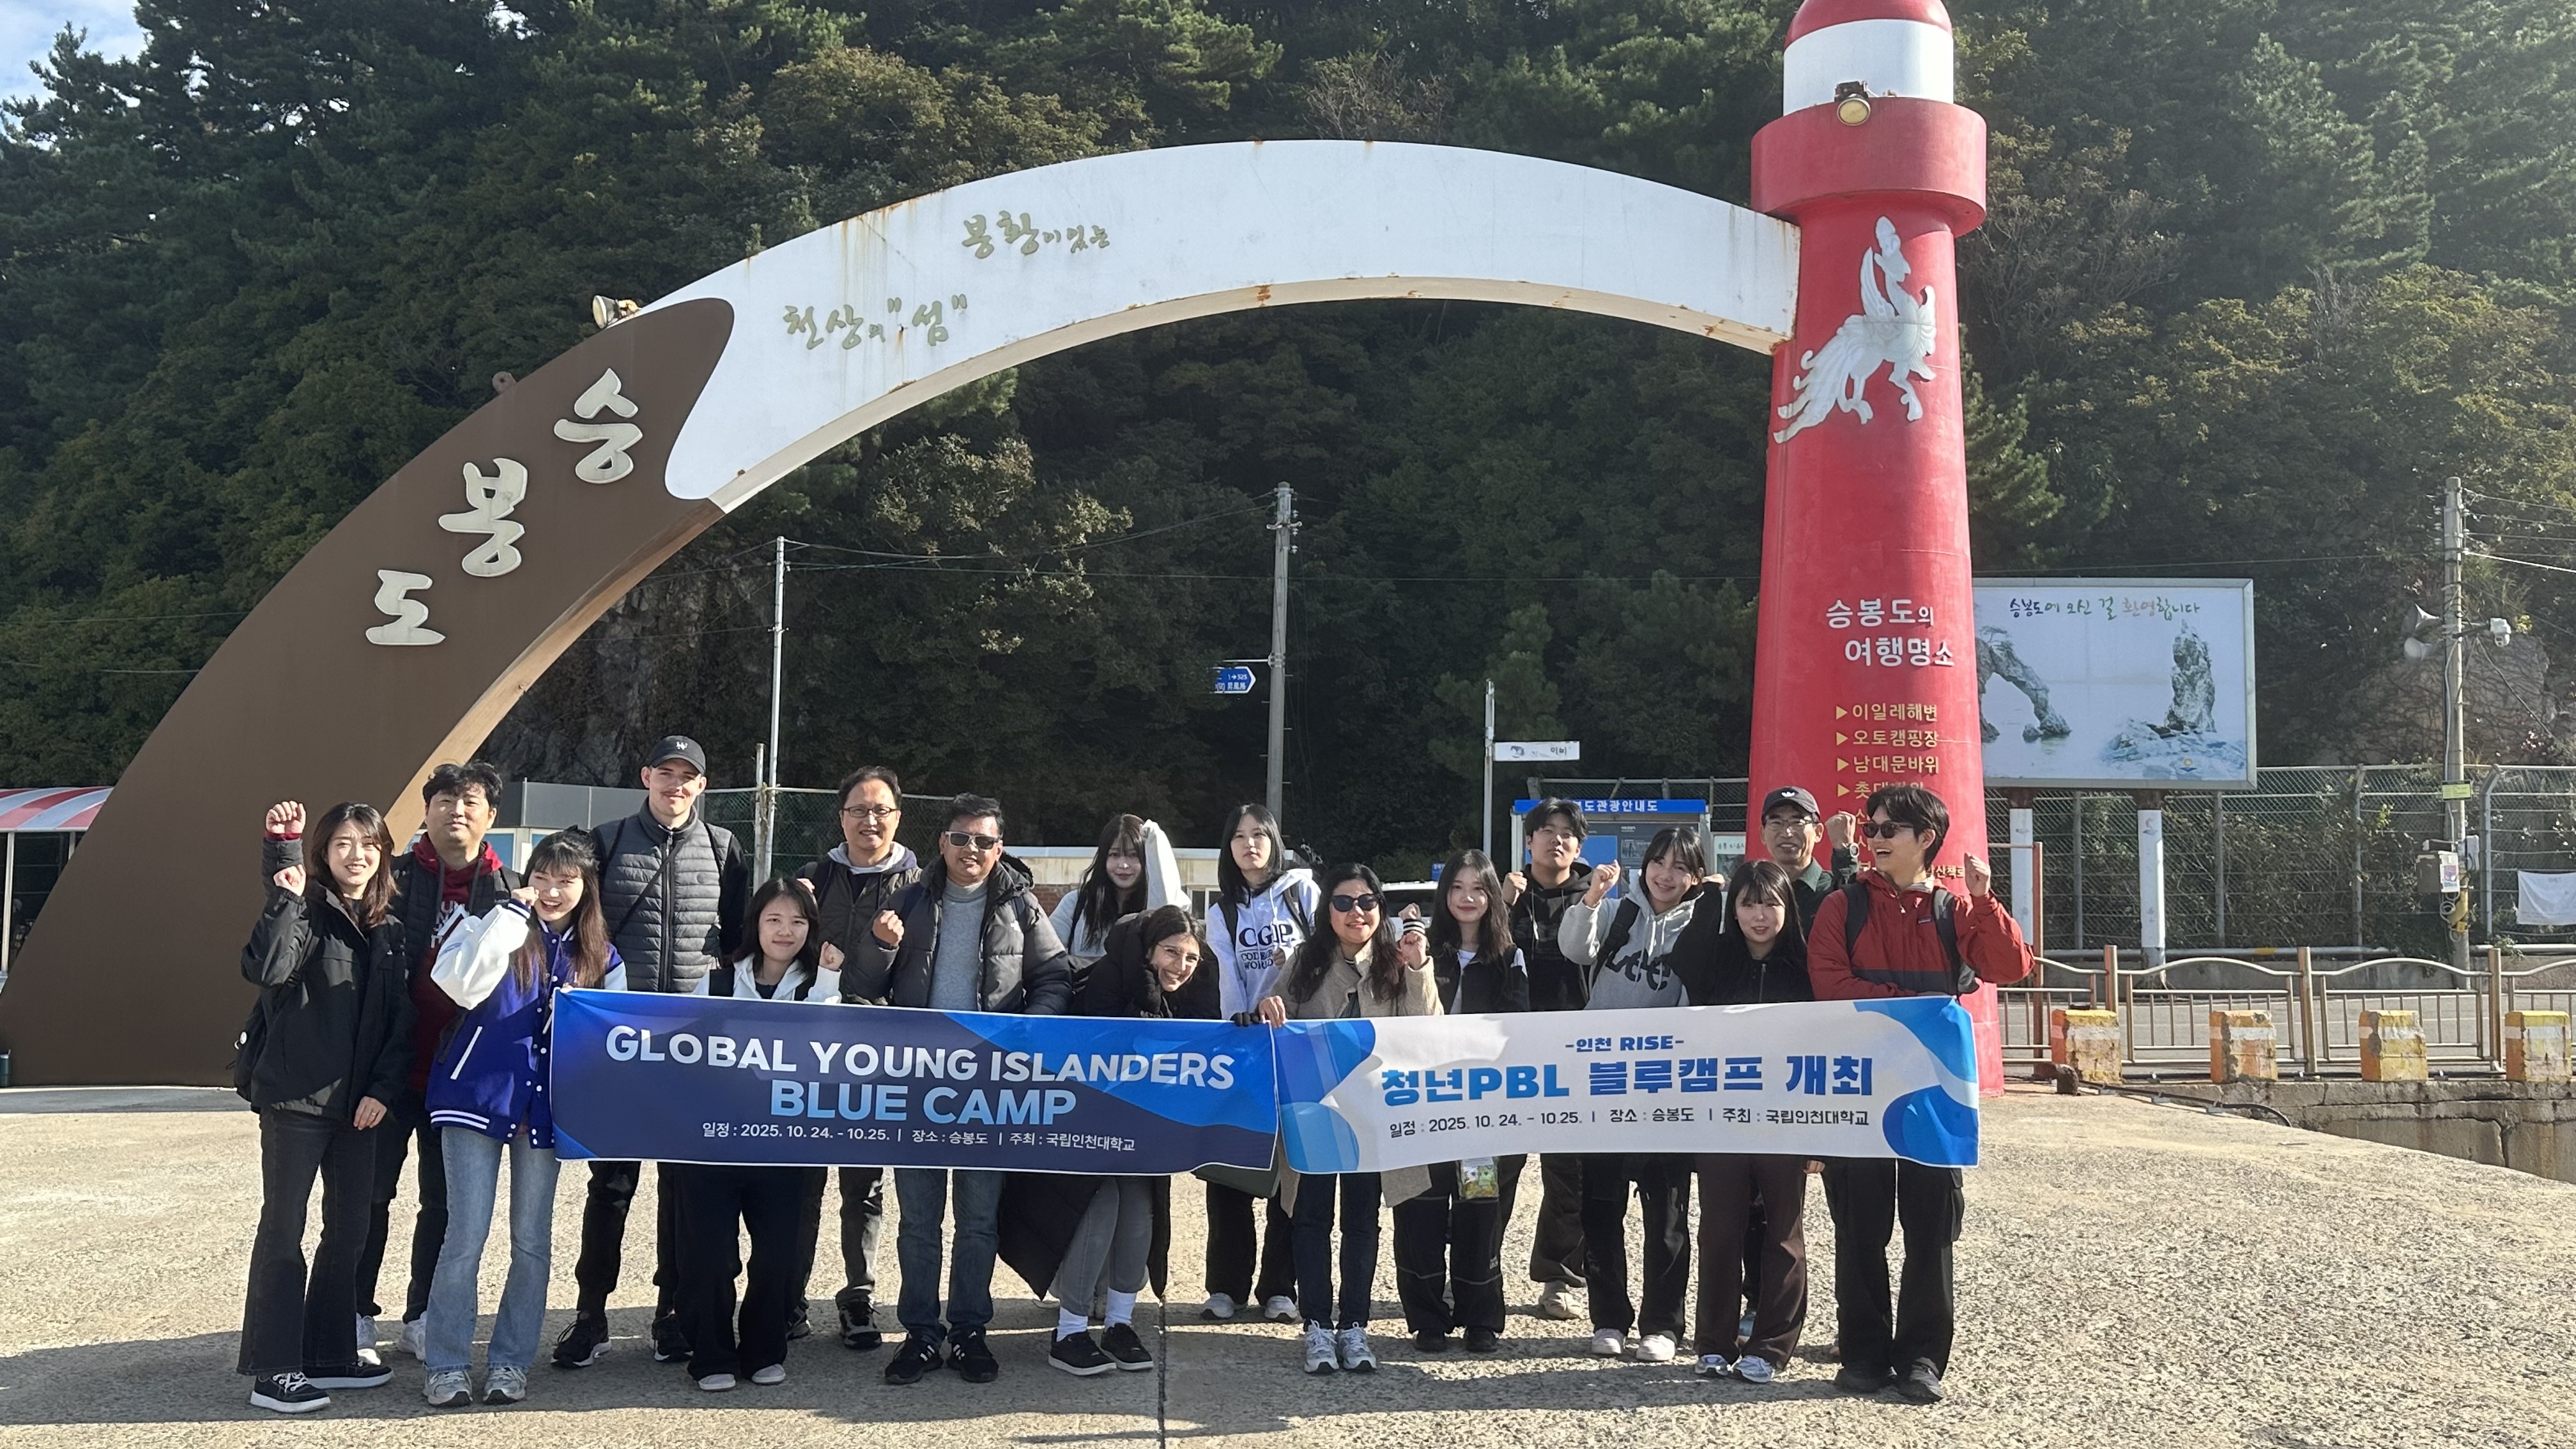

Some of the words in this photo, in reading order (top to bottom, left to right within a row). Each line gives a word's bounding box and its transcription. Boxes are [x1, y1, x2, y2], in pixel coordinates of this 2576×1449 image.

[1825, 598, 1934, 629] 승봉도의
[2009, 598, 2060, 618] 승봉도에
[2067, 598, 2092, 615] 오신
[2099, 597, 2116, 620] 걸
[2122, 596, 2200, 621] 환영합니다
[1844, 636, 1955, 667] 여행명소
[1853, 703, 1938, 722] 이일레해변
[1853, 730, 1938, 748] 오토캠핑장
[1853, 756, 1939, 774] 남대문바위
[1573, 800, 1658, 813] 도관광안내도
[606, 1025, 797, 1072] GLOBAL
[809, 1041, 979, 1081] YOUNG
[990, 1051, 1236, 1091] ISLANDERS
[1381, 1064, 1570, 1107] 청년PBL
[1588, 1056, 1763, 1096] 블루캠프
[1786, 1055, 1873, 1096] 개최
[770, 1079, 908, 1121] BLUE
[923, 1086, 1077, 1125] CAMP
[702, 1122, 730, 1138] 일정
[740, 1124, 783, 1138] 2025.
[786, 1125, 807, 1138] 10.
[810, 1127, 834, 1139] 24.
[912, 1130, 939, 1143] 장소
[948, 1131, 988, 1146] 승봉도
[1009, 1132, 1036, 1146] 주최
[1045, 1132, 1135, 1151] 국립인천대학교
[1389, 1120, 1416, 1138] 일정
[1429, 1117, 1470, 1133] 2025.
[1475, 1115, 1495, 1128] 10.
[1498, 1114, 1522, 1126] 24.
[1609, 1108, 1638, 1123] 장소
[1652, 1108, 1695, 1123] 승봉도
[1722, 1108, 1751, 1124] 주최
[1765, 1108, 1869, 1126] 국립인천대학교
